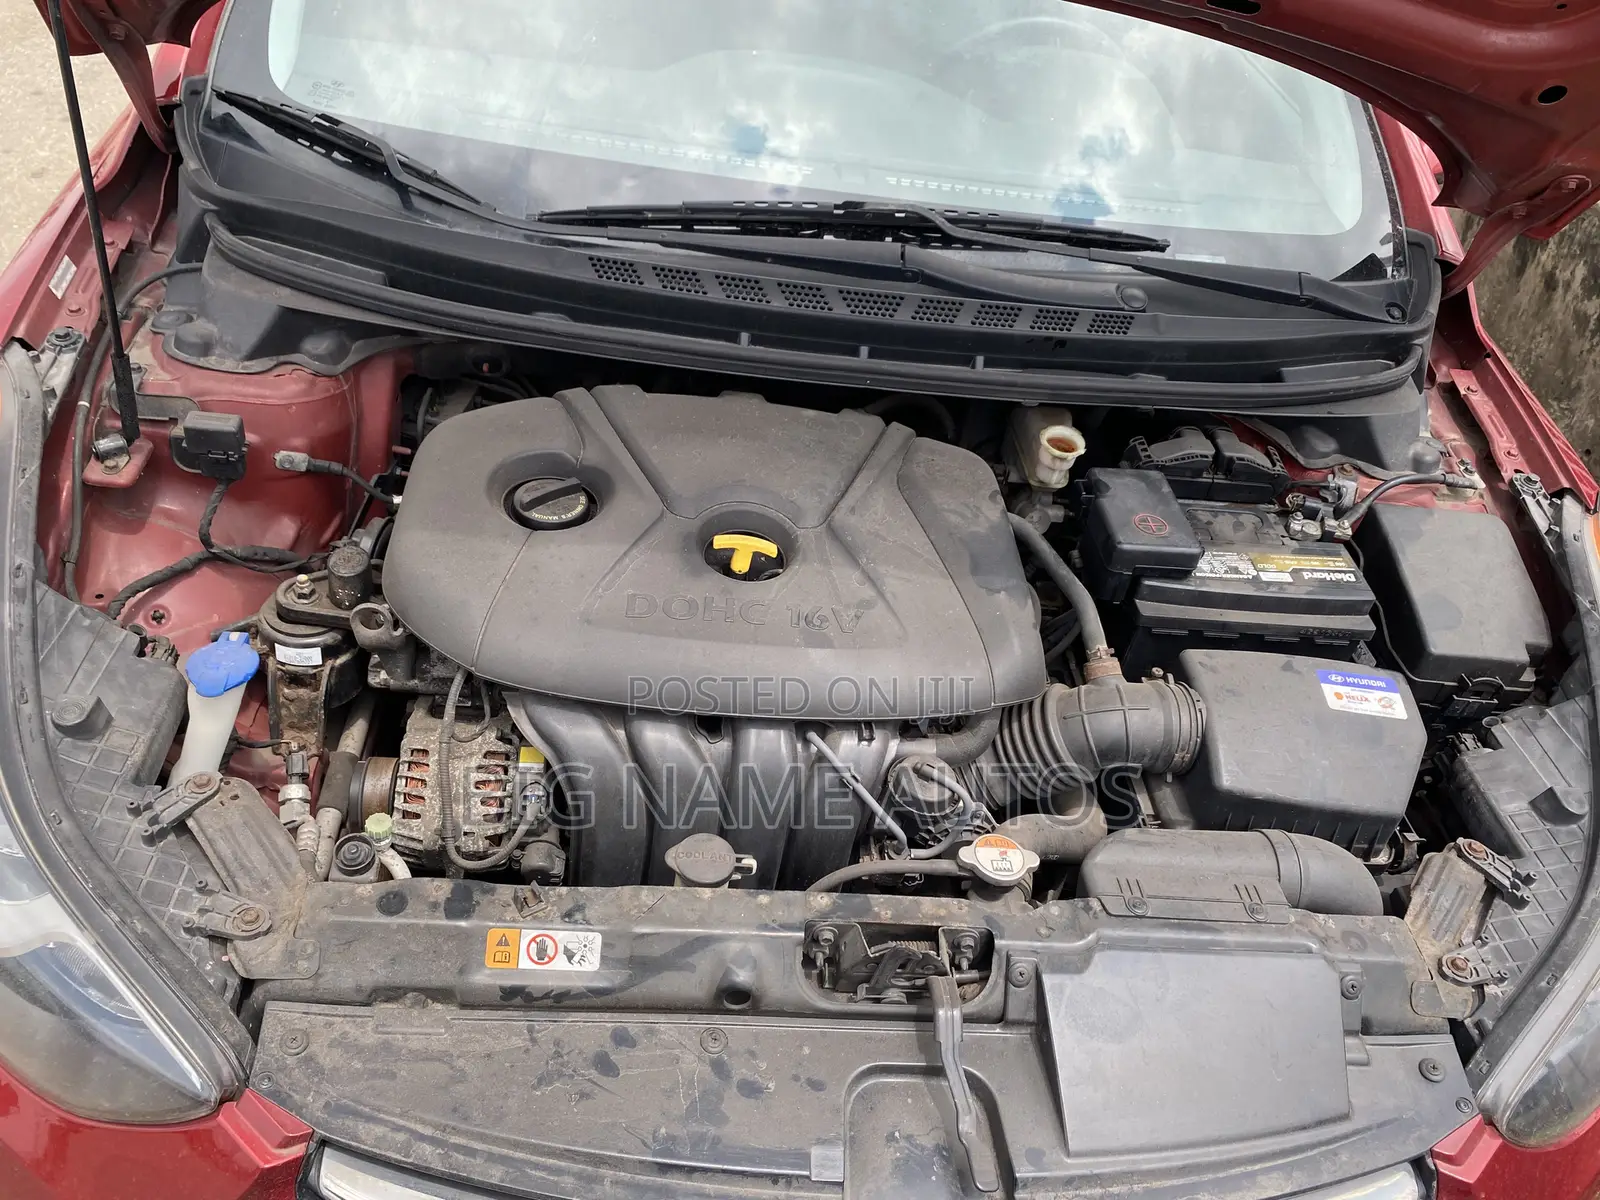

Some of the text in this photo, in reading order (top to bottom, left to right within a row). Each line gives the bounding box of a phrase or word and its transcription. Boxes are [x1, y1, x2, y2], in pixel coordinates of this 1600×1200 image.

[531, 511, 559, 520] MANUAL
[1302, 571, 1357, 582] DieHard
[624, 593, 865, 634] DOHC 16V
[1345, 676, 1387, 688] HYUNDAI
[677, 850, 733, 863] COOLANT
